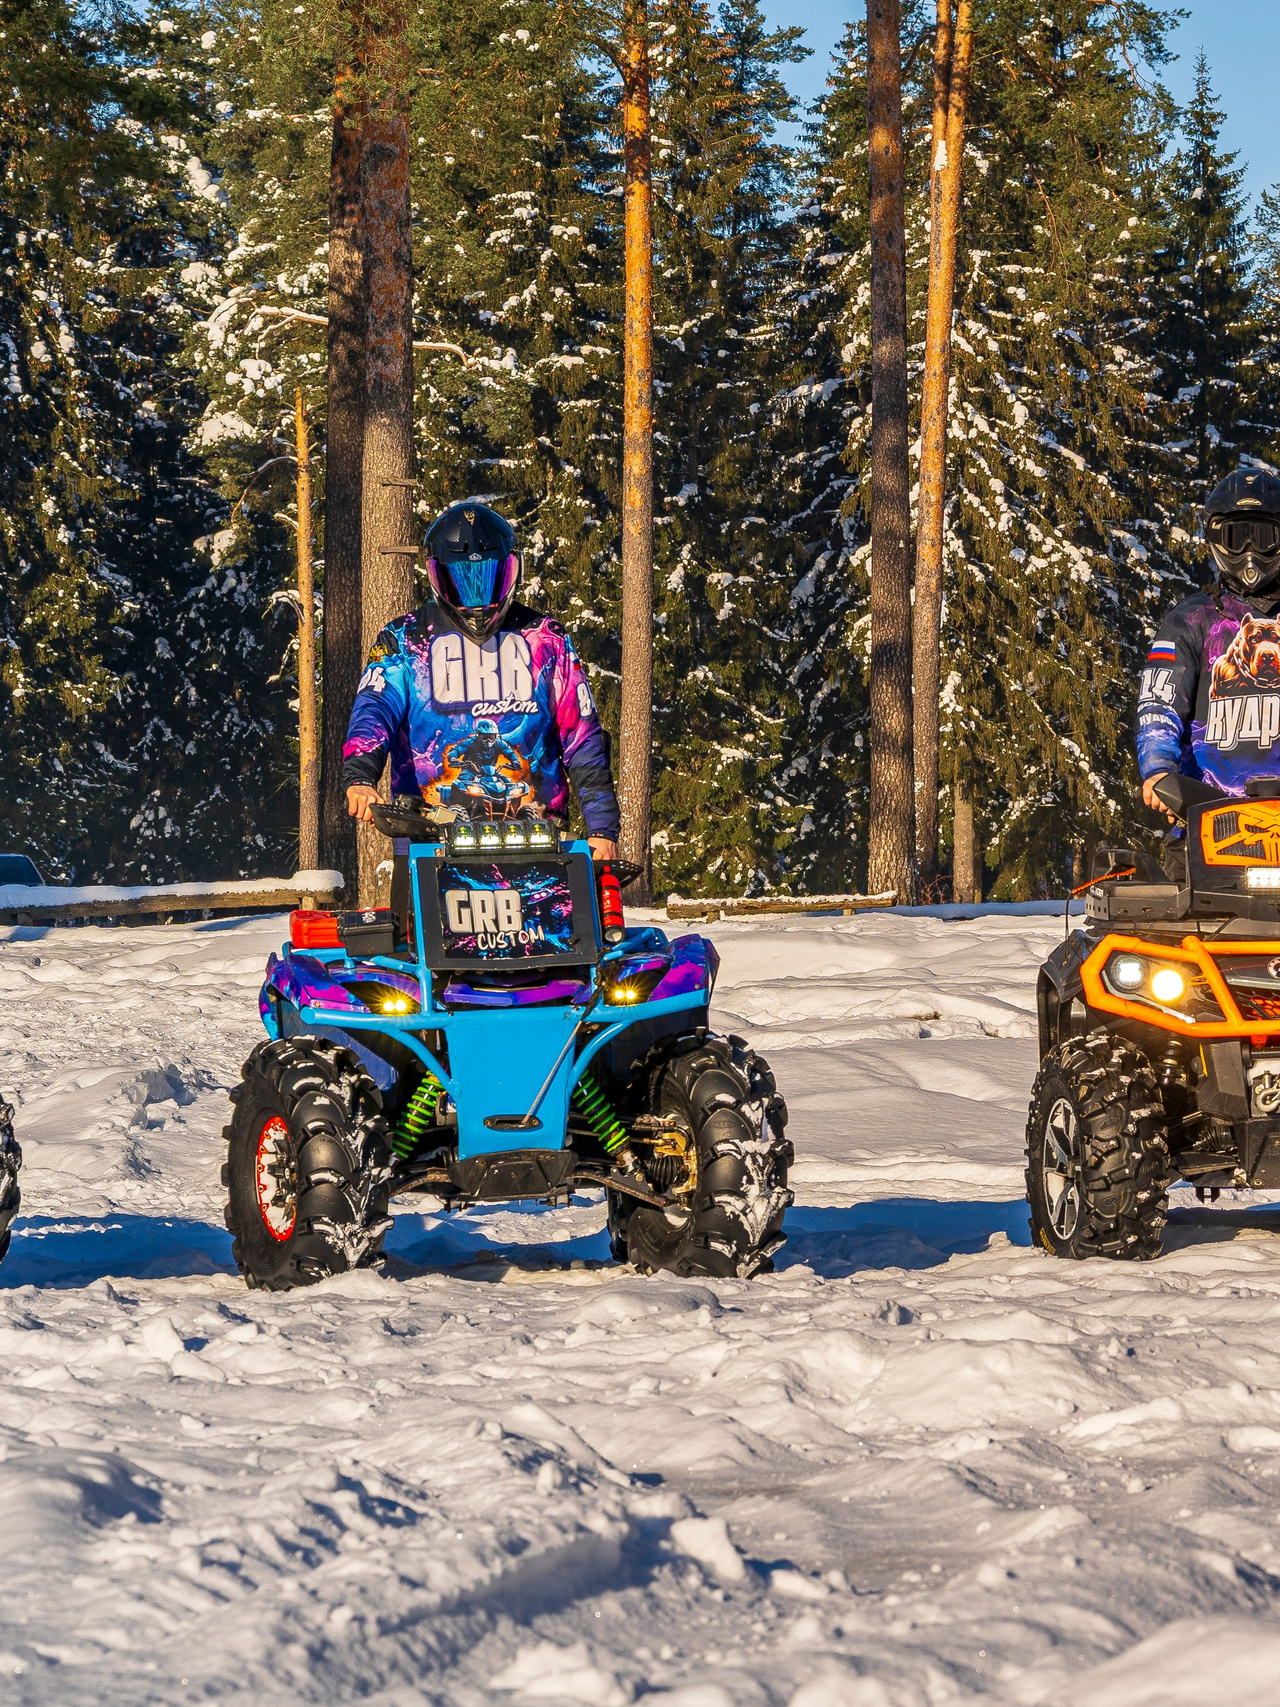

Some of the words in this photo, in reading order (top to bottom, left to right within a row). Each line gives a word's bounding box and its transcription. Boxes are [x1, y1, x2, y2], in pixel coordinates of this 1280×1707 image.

[1138, 668, 1176, 704] 14
[471, 692, 539, 717] custom
[445, 889, 523, 934] GRB
[477, 925, 546, 951] CUSTOM
